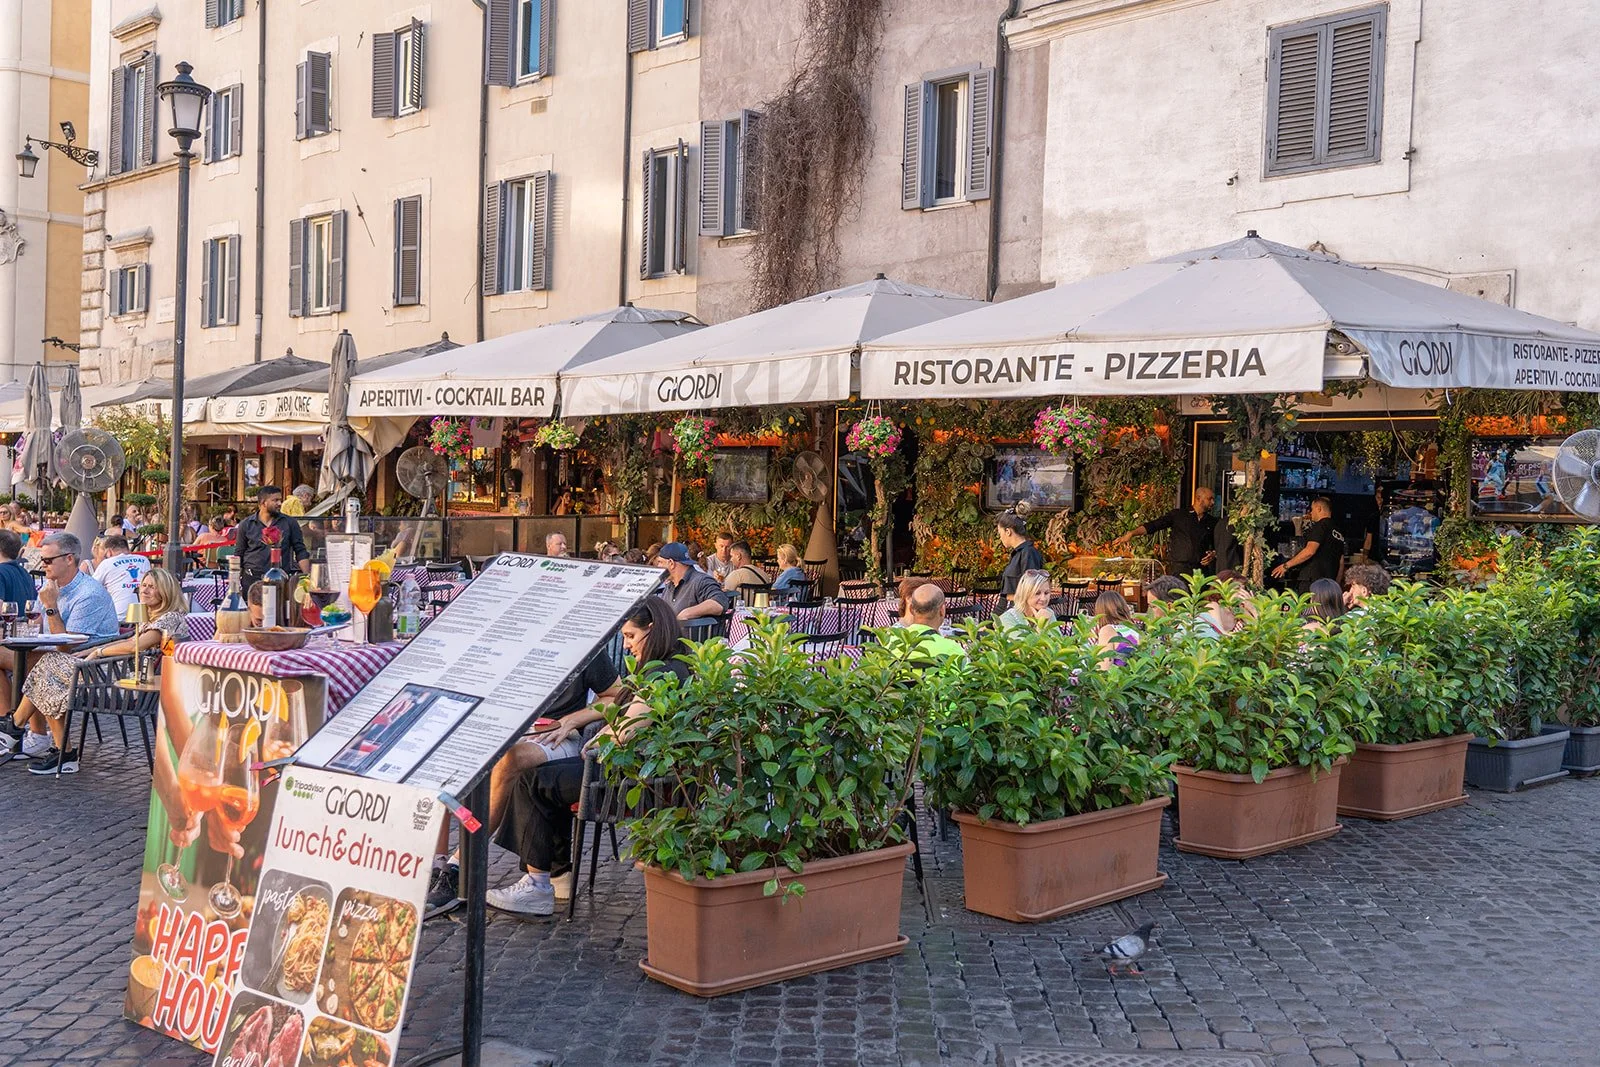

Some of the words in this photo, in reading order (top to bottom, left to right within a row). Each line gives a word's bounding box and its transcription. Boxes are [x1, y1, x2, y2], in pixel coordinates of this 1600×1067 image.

[894, 354, 1075, 386] RISTORANTE
[1104, 347, 1267, 380] PIZZERIA
[1400, 339, 1453, 376] GIORDI
[1513, 343, 1568, 362] RISTORANTE
[657, 372, 722, 403] GIORDI
[1514, 369, 1558, 386] APERITIVI
[359, 388, 423, 407] APERITIVI
[435, 387, 507, 406] COCKTAIL
[511, 387, 545, 406] BAR
[112, 558, 145, 568] EVERYDAY
[496, 555, 538, 569] GIORDI
[195, 668, 282, 724] GIORDI
[294, 779, 325, 793] Tripadvisor
[325, 785, 391, 824] GIORDI
[274, 815, 424, 879] lunch&dinner
[257, 885, 297, 915] pasta
[337, 899, 380, 928] pizza
[153, 966, 232, 1048] HOU
